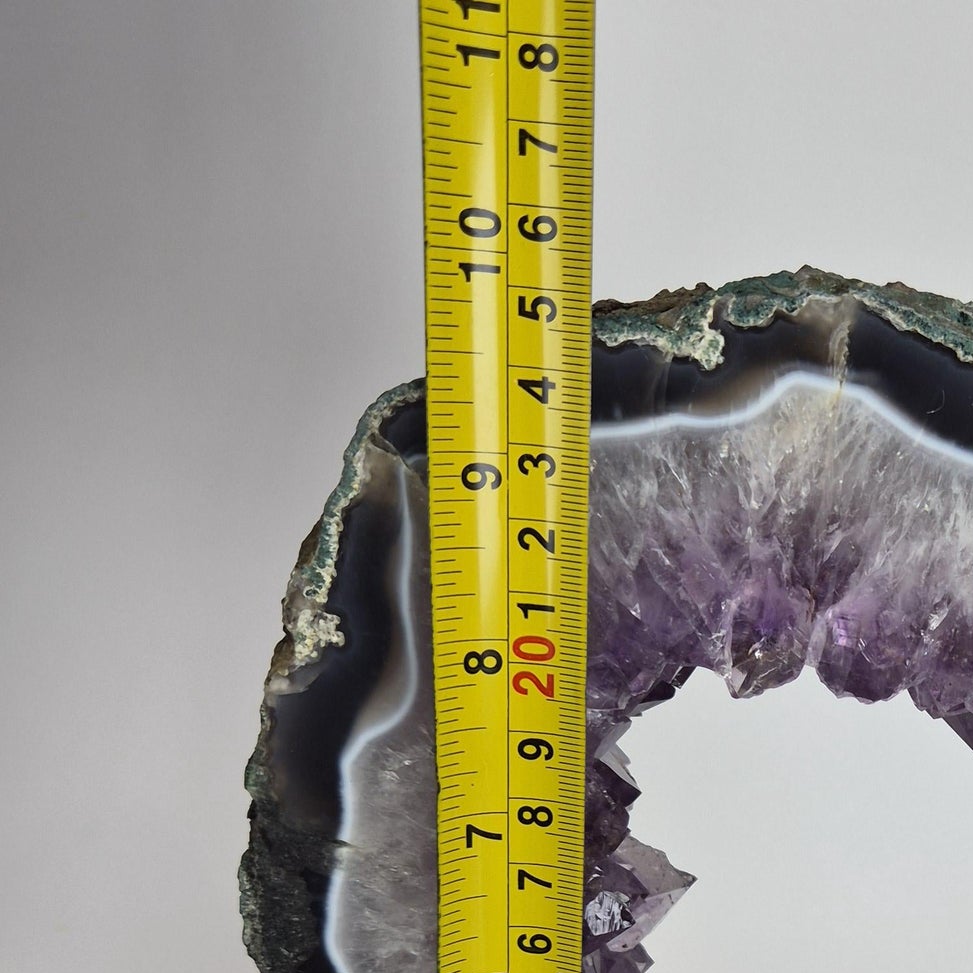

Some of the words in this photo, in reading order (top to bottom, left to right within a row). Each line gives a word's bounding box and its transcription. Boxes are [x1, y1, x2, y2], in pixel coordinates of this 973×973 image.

[518, 43, 559, 72] 8
[518, 128, 558, 156] 7
[517, 214, 558, 243] 6
[458, 207, 502, 283] 10
[517, 295, 557, 323] 5
[517, 376, 556, 404] 4
[461, 462, 502, 490] 9
[517, 452, 556, 478] 3
[517, 526, 555, 554] 2
[517, 602, 555, 619] 1
[463, 649, 503, 675] 8
[512, 635, 555, 698] 20
[517, 737, 554, 761] 9
[517, 805, 554, 828] 8
[466, 824, 503, 848] 7
[517, 868, 553, 890] 7
[517, 933, 553, 955] 6
